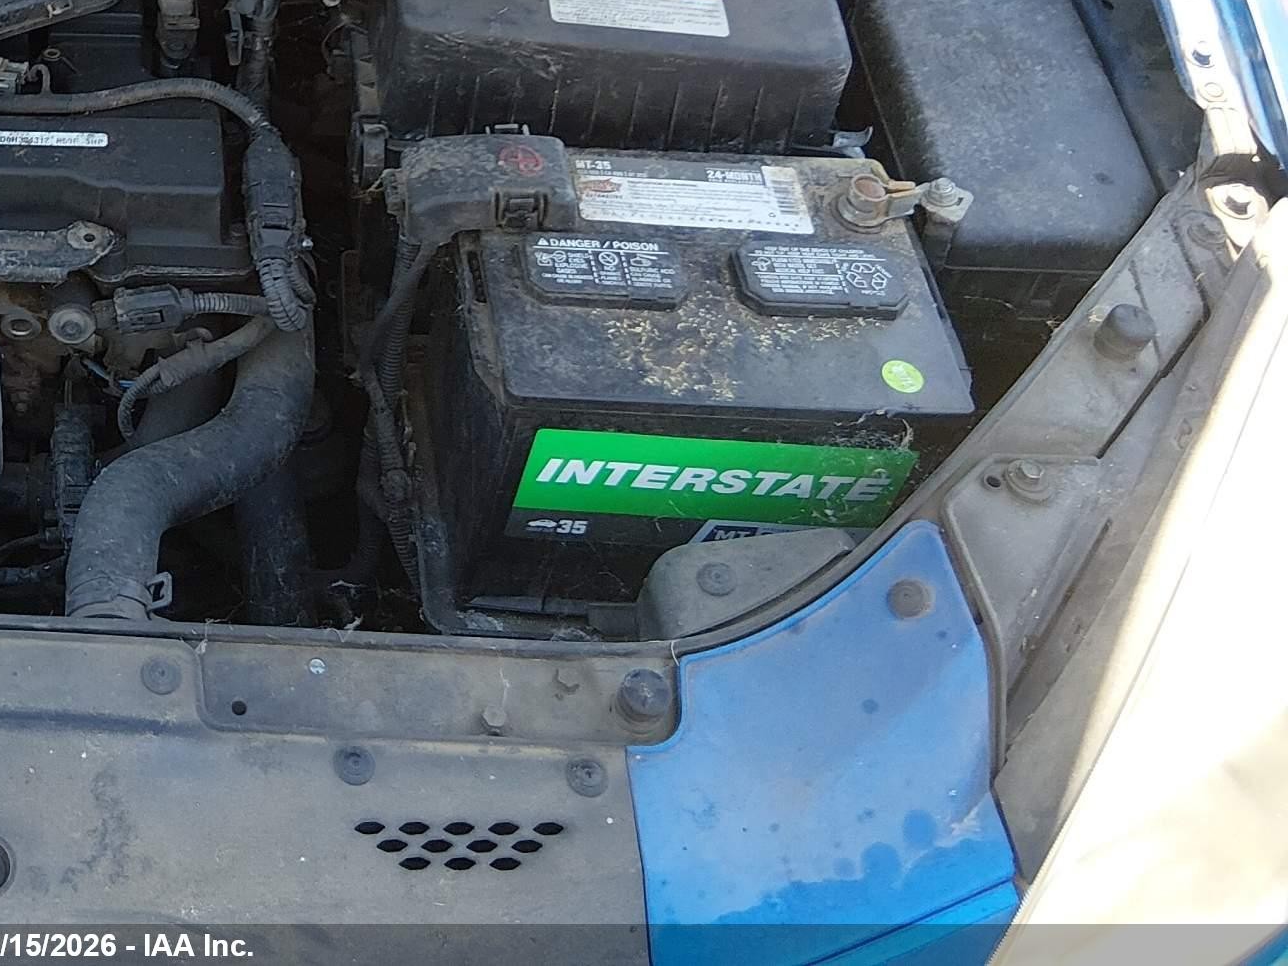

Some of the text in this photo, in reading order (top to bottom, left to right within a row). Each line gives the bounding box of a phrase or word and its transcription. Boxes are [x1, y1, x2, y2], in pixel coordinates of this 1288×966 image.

[550, 239, 600, 248] DANGER
[612, 241, 659, 252] POISON
[535, 458, 893, 502] INTERSTATE
[556, 519, 589, 534] 35
